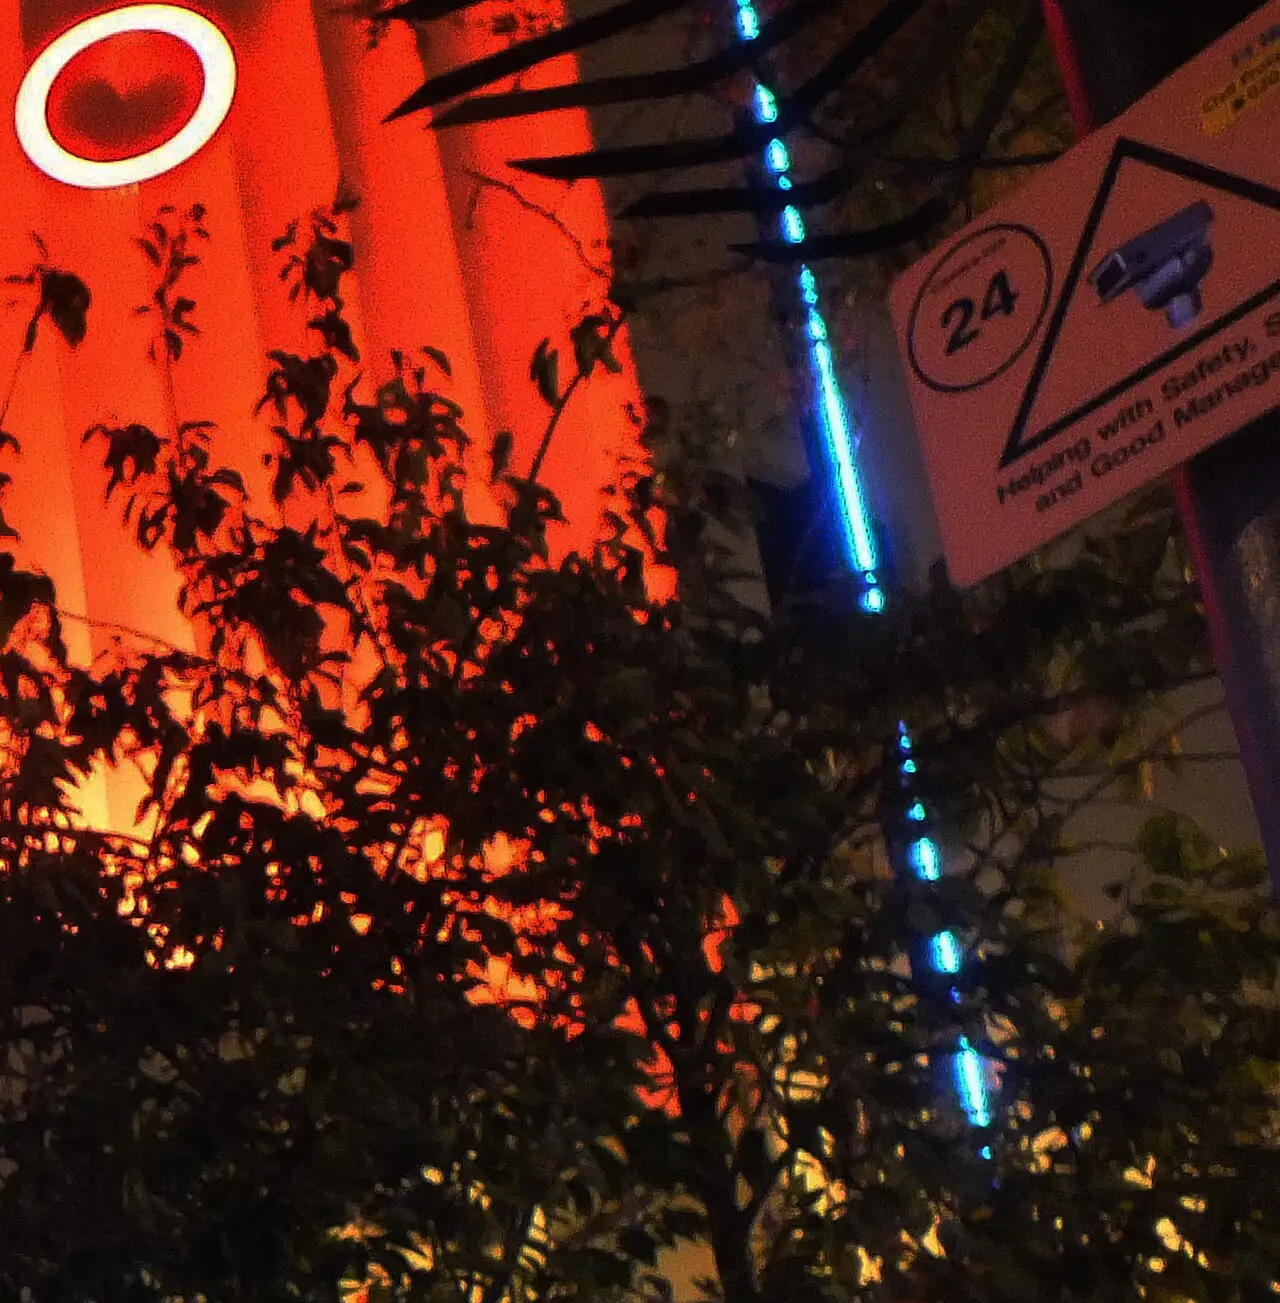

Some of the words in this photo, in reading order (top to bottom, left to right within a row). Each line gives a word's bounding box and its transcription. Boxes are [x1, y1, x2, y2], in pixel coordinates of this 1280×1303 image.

[940, 268, 1019, 357] 24
[996, 434, 1092, 504] Helping
[1097, 398, 1154, 441] with
[1034, 468, 1083, 513] and
[1090, 420, 1166, 478] Good
